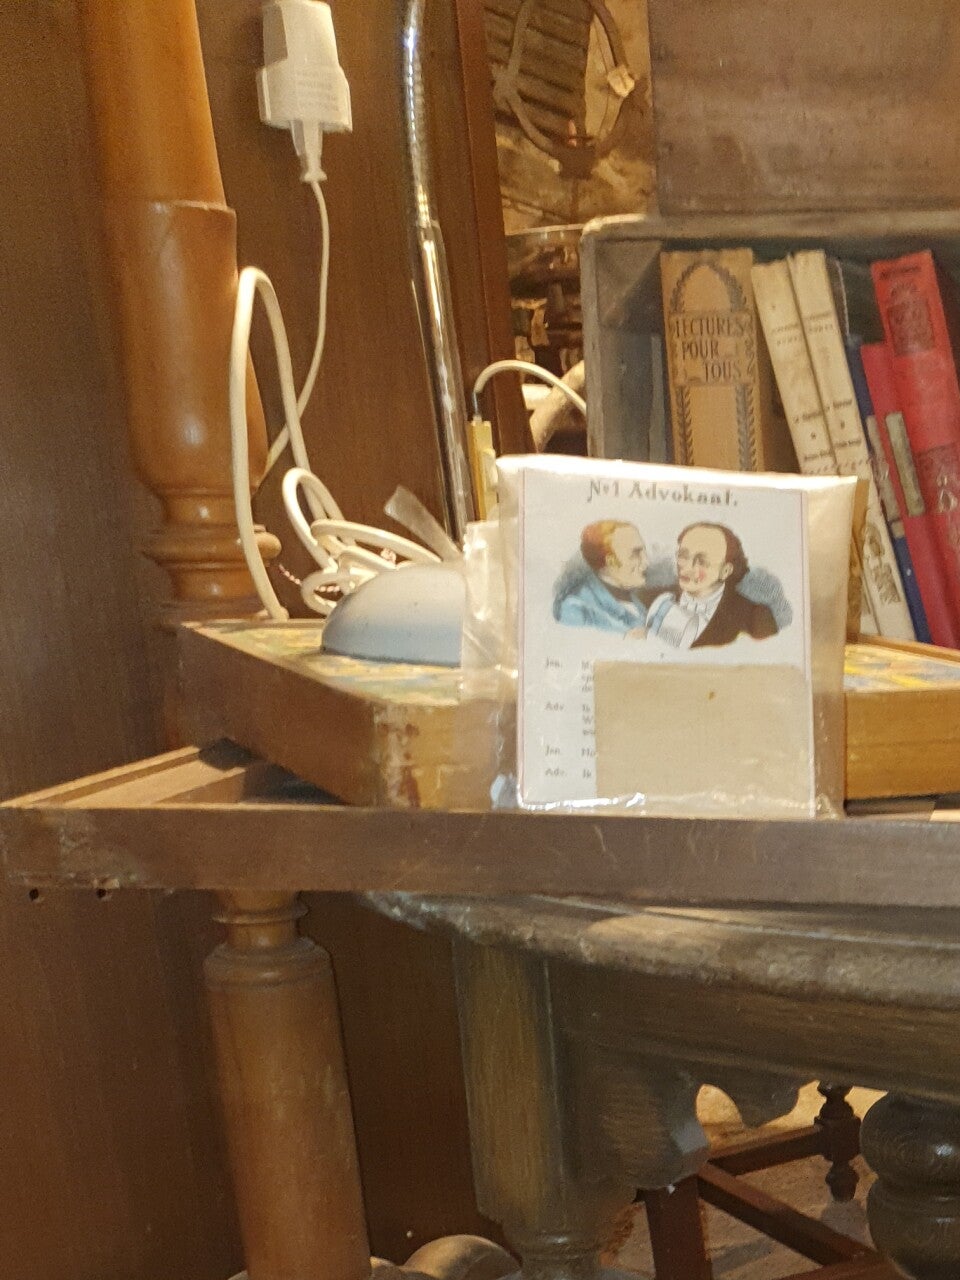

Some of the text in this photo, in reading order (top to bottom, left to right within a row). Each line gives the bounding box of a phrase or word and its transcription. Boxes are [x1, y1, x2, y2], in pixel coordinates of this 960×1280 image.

[674, 316, 745, 338] LECTURES
[682, 337, 719, 360] POUR
[702, 359, 743, 384] TOUS
